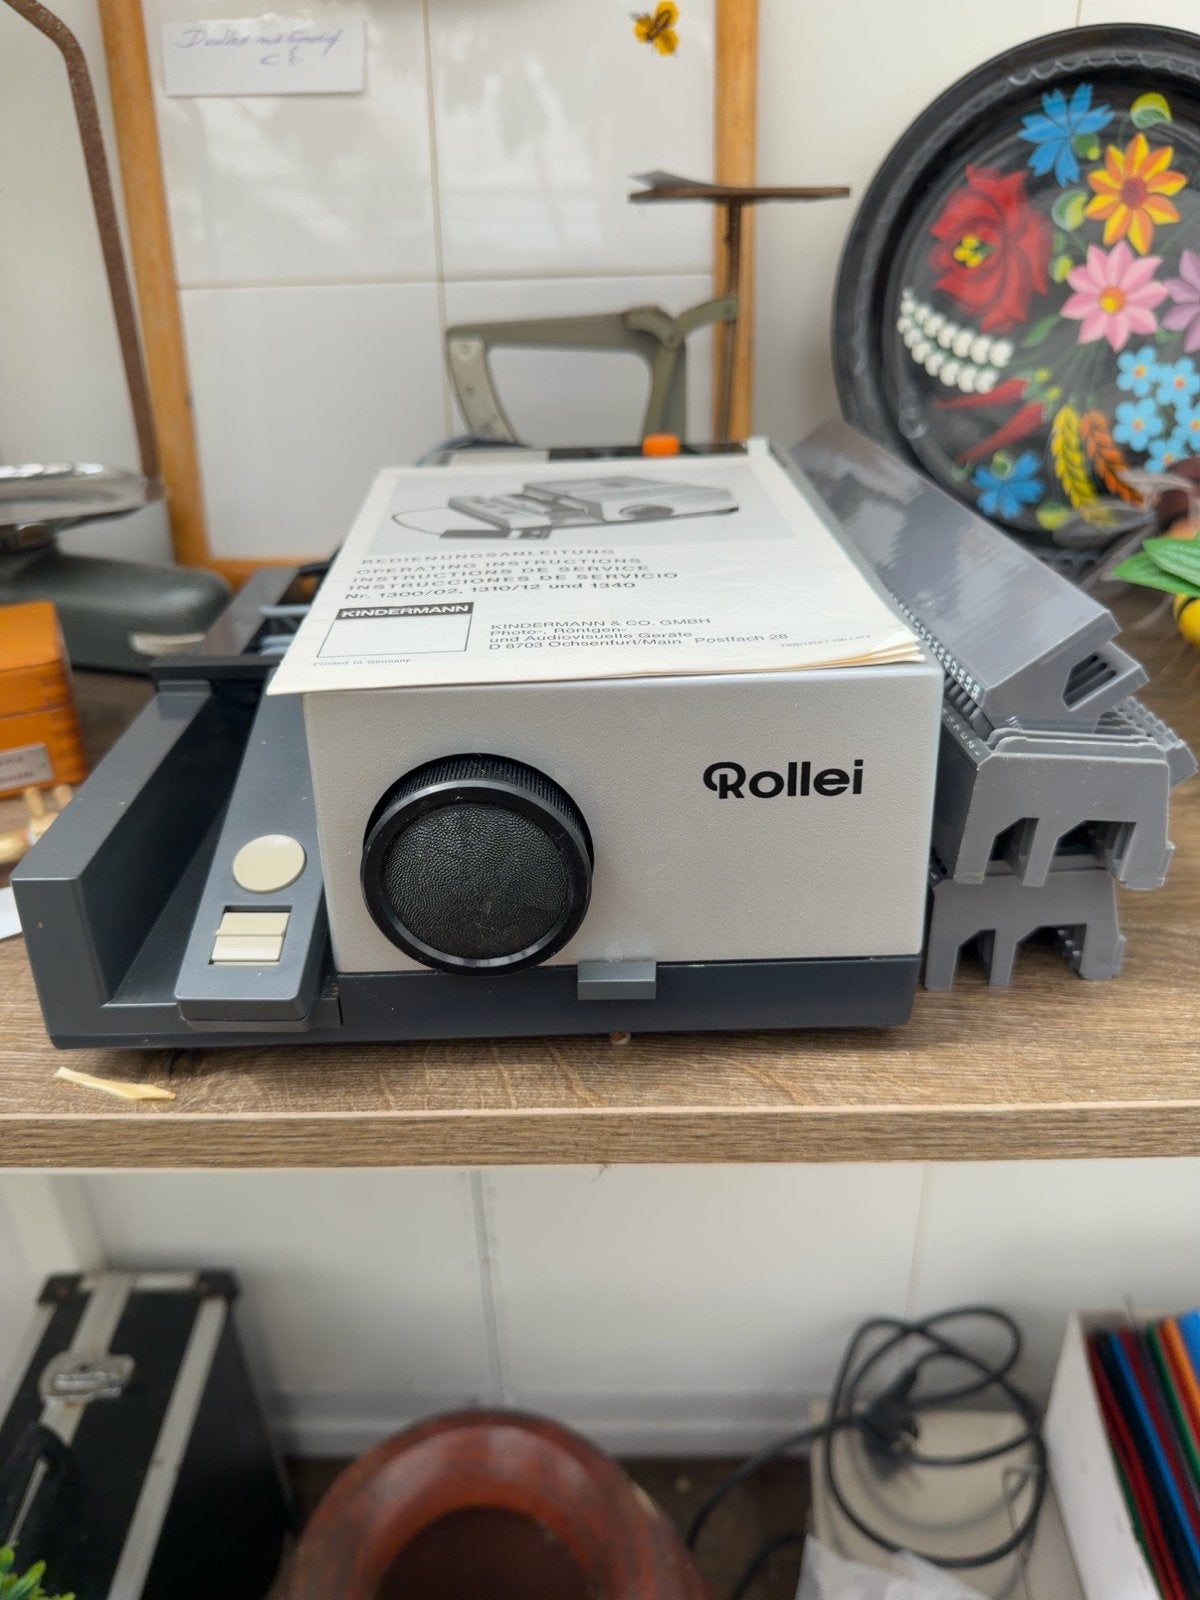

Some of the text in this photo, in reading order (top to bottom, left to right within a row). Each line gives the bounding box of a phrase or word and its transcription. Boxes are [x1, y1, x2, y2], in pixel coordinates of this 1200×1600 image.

[362, 549, 615, 565] BEDIENUNGSANLEITUNG
[353, 568, 513, 583] INSTRUCTIONS
[558, 565, 649, 573] SERVICE
[356, 557, 641, 575] OPERATING INSTRUCTIONS
[349, 575, 530, 591] INSTRUCCIONES
[576, 572, 678, 580] SERVICIO
[345, 592, 371, 600] Nr.
[471, 583, 541, 592] 1310/12
[341, 604, 469, 618] KINDERMANN
[491, 619, 606, 630] KINDERMANN
[625, 619, 655, 627] CO.
[660, 617, 711, 626] GMBH
[554, 627, 627, 635] Röntgen-
[505, 642, 543, 650] 8703
[548, 638, 682, 648] Ochsenfurt/Main
[694, 635, 764, 644] Postfach
[524, 632, 633, 642] Audiovisuelle
[638, 631, 693, 639] Geräte
[702, 758, 864, 800] Rollei
